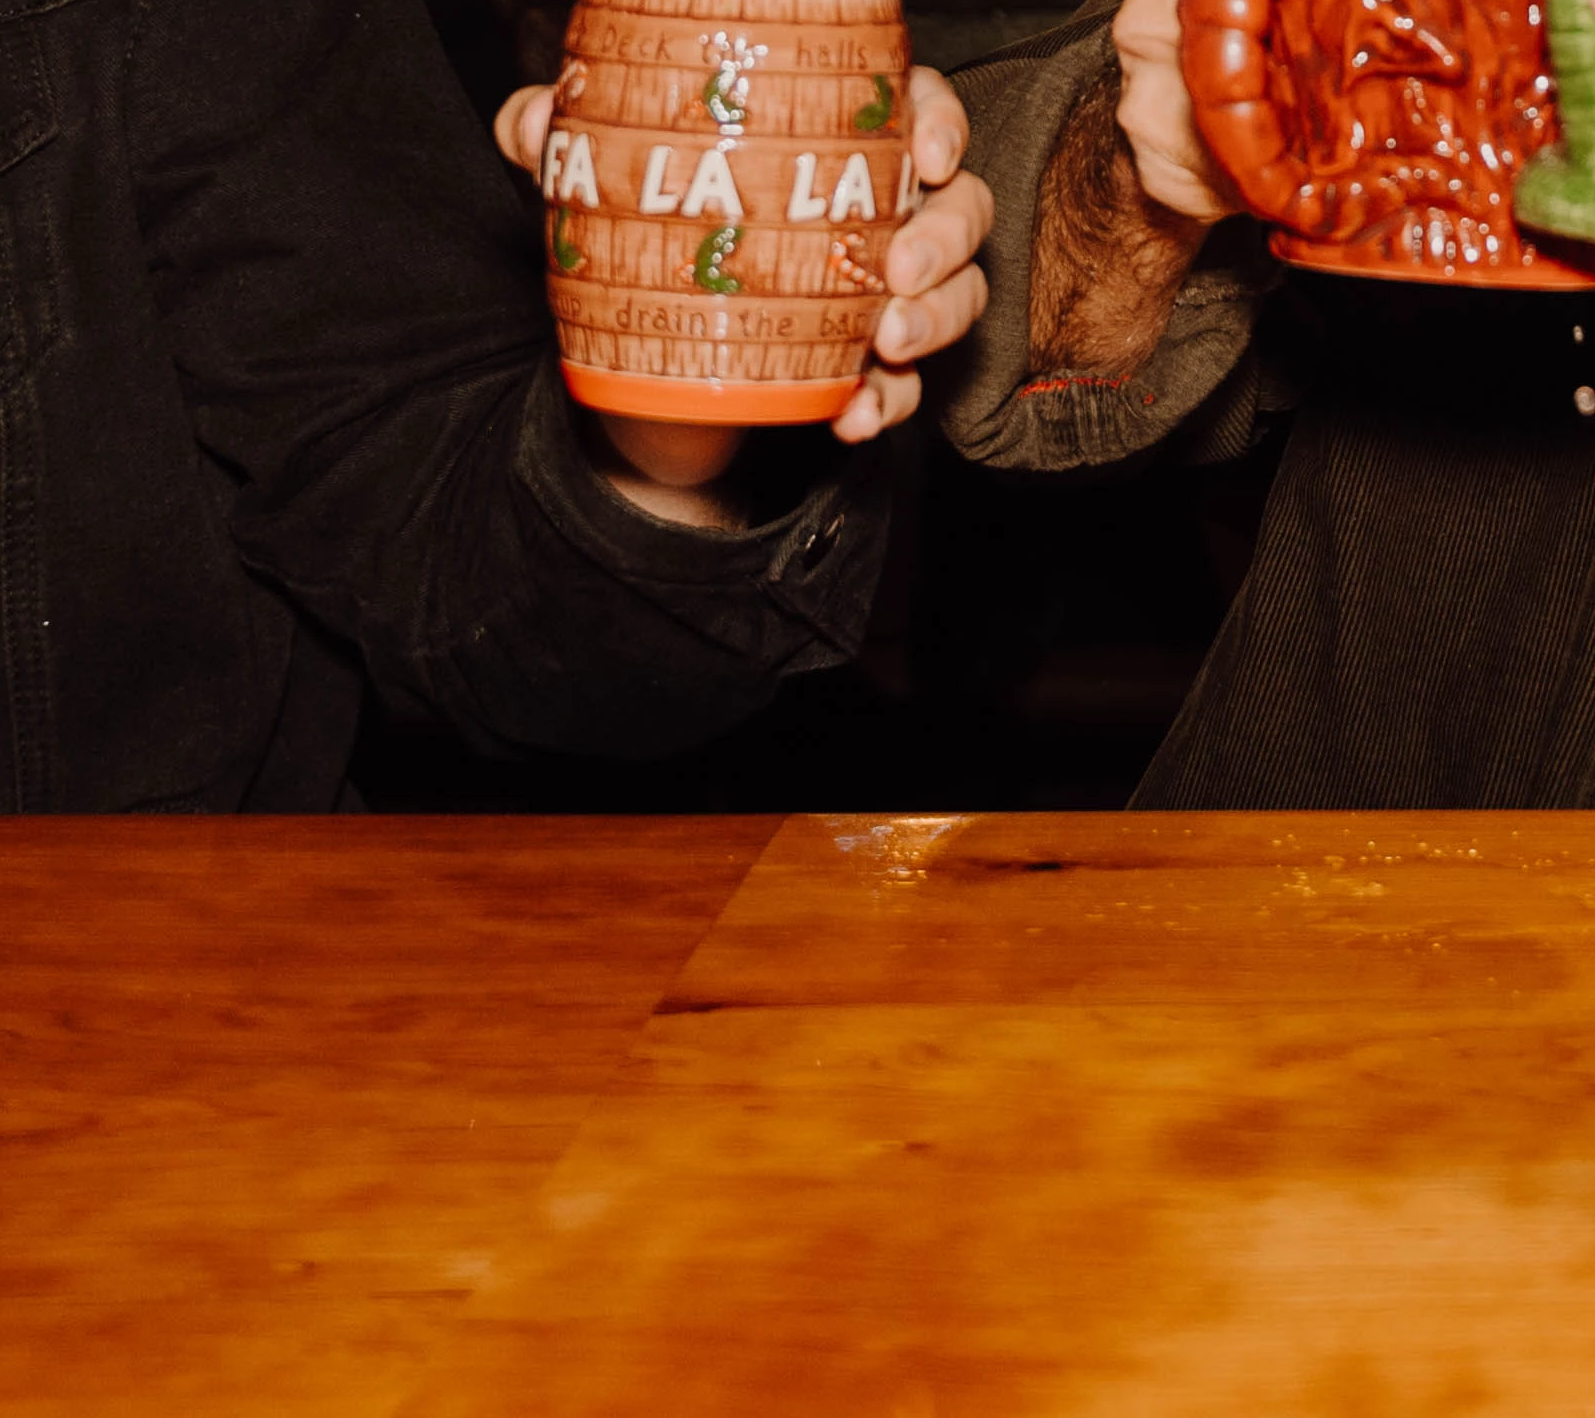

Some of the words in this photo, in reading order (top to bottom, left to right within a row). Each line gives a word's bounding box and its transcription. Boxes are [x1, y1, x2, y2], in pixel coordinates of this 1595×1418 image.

[796, 38, 868, 70] halls
[544, 131, 599, 208] FA
[640, 145, 743, 218] LA
[787, 152, 876, 223] LA
[616, 298, 707, 337] drain
[738, 307, 795, 339] the
